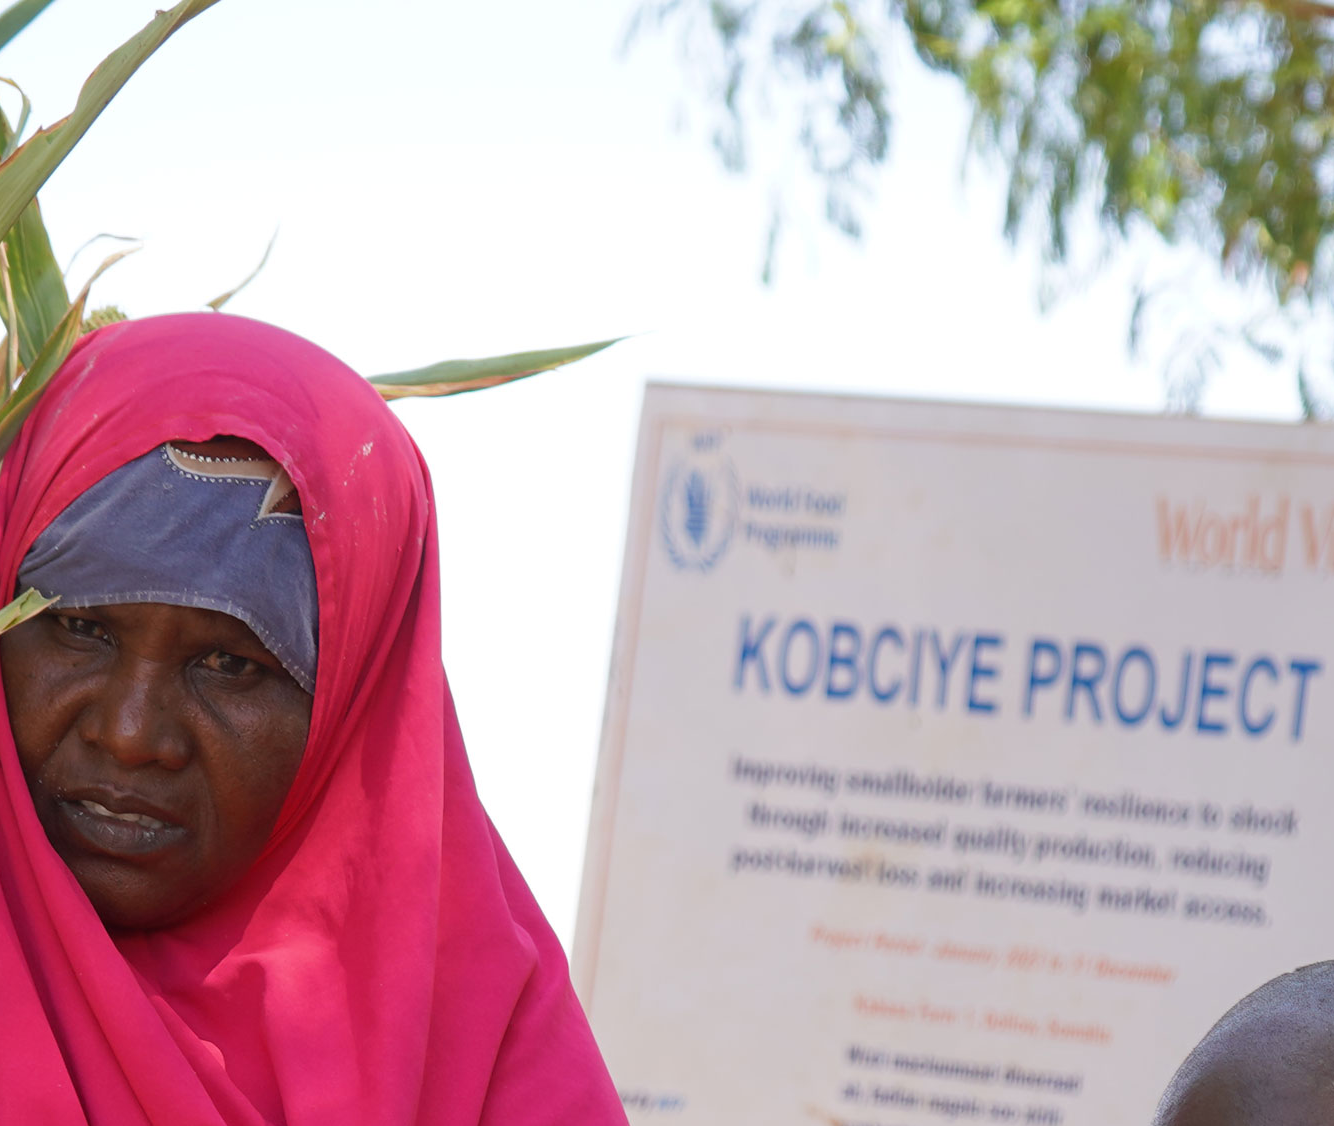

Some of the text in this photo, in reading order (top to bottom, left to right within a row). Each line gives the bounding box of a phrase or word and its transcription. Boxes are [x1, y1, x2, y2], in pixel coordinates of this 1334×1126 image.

[1156, 494, 1290, 571] World
[734, 614, 1323, 743] KOBCIYE PROJECT
[733, 757, 839, 797] Improving
[845, 770, 974, 802] smallholder
[1083, 791, 1192, 824] resilience
[1229, 805, 1298, 836] shock
[747, 803, 828, 840] through
[839, 814, 947, 843] increased
[954, 827, 1031, 861] quality
[1171, 849, 1269, 886] reducing
[975, 873, 1091, 912] increasing
[1097, 886, 1179, 916] market
